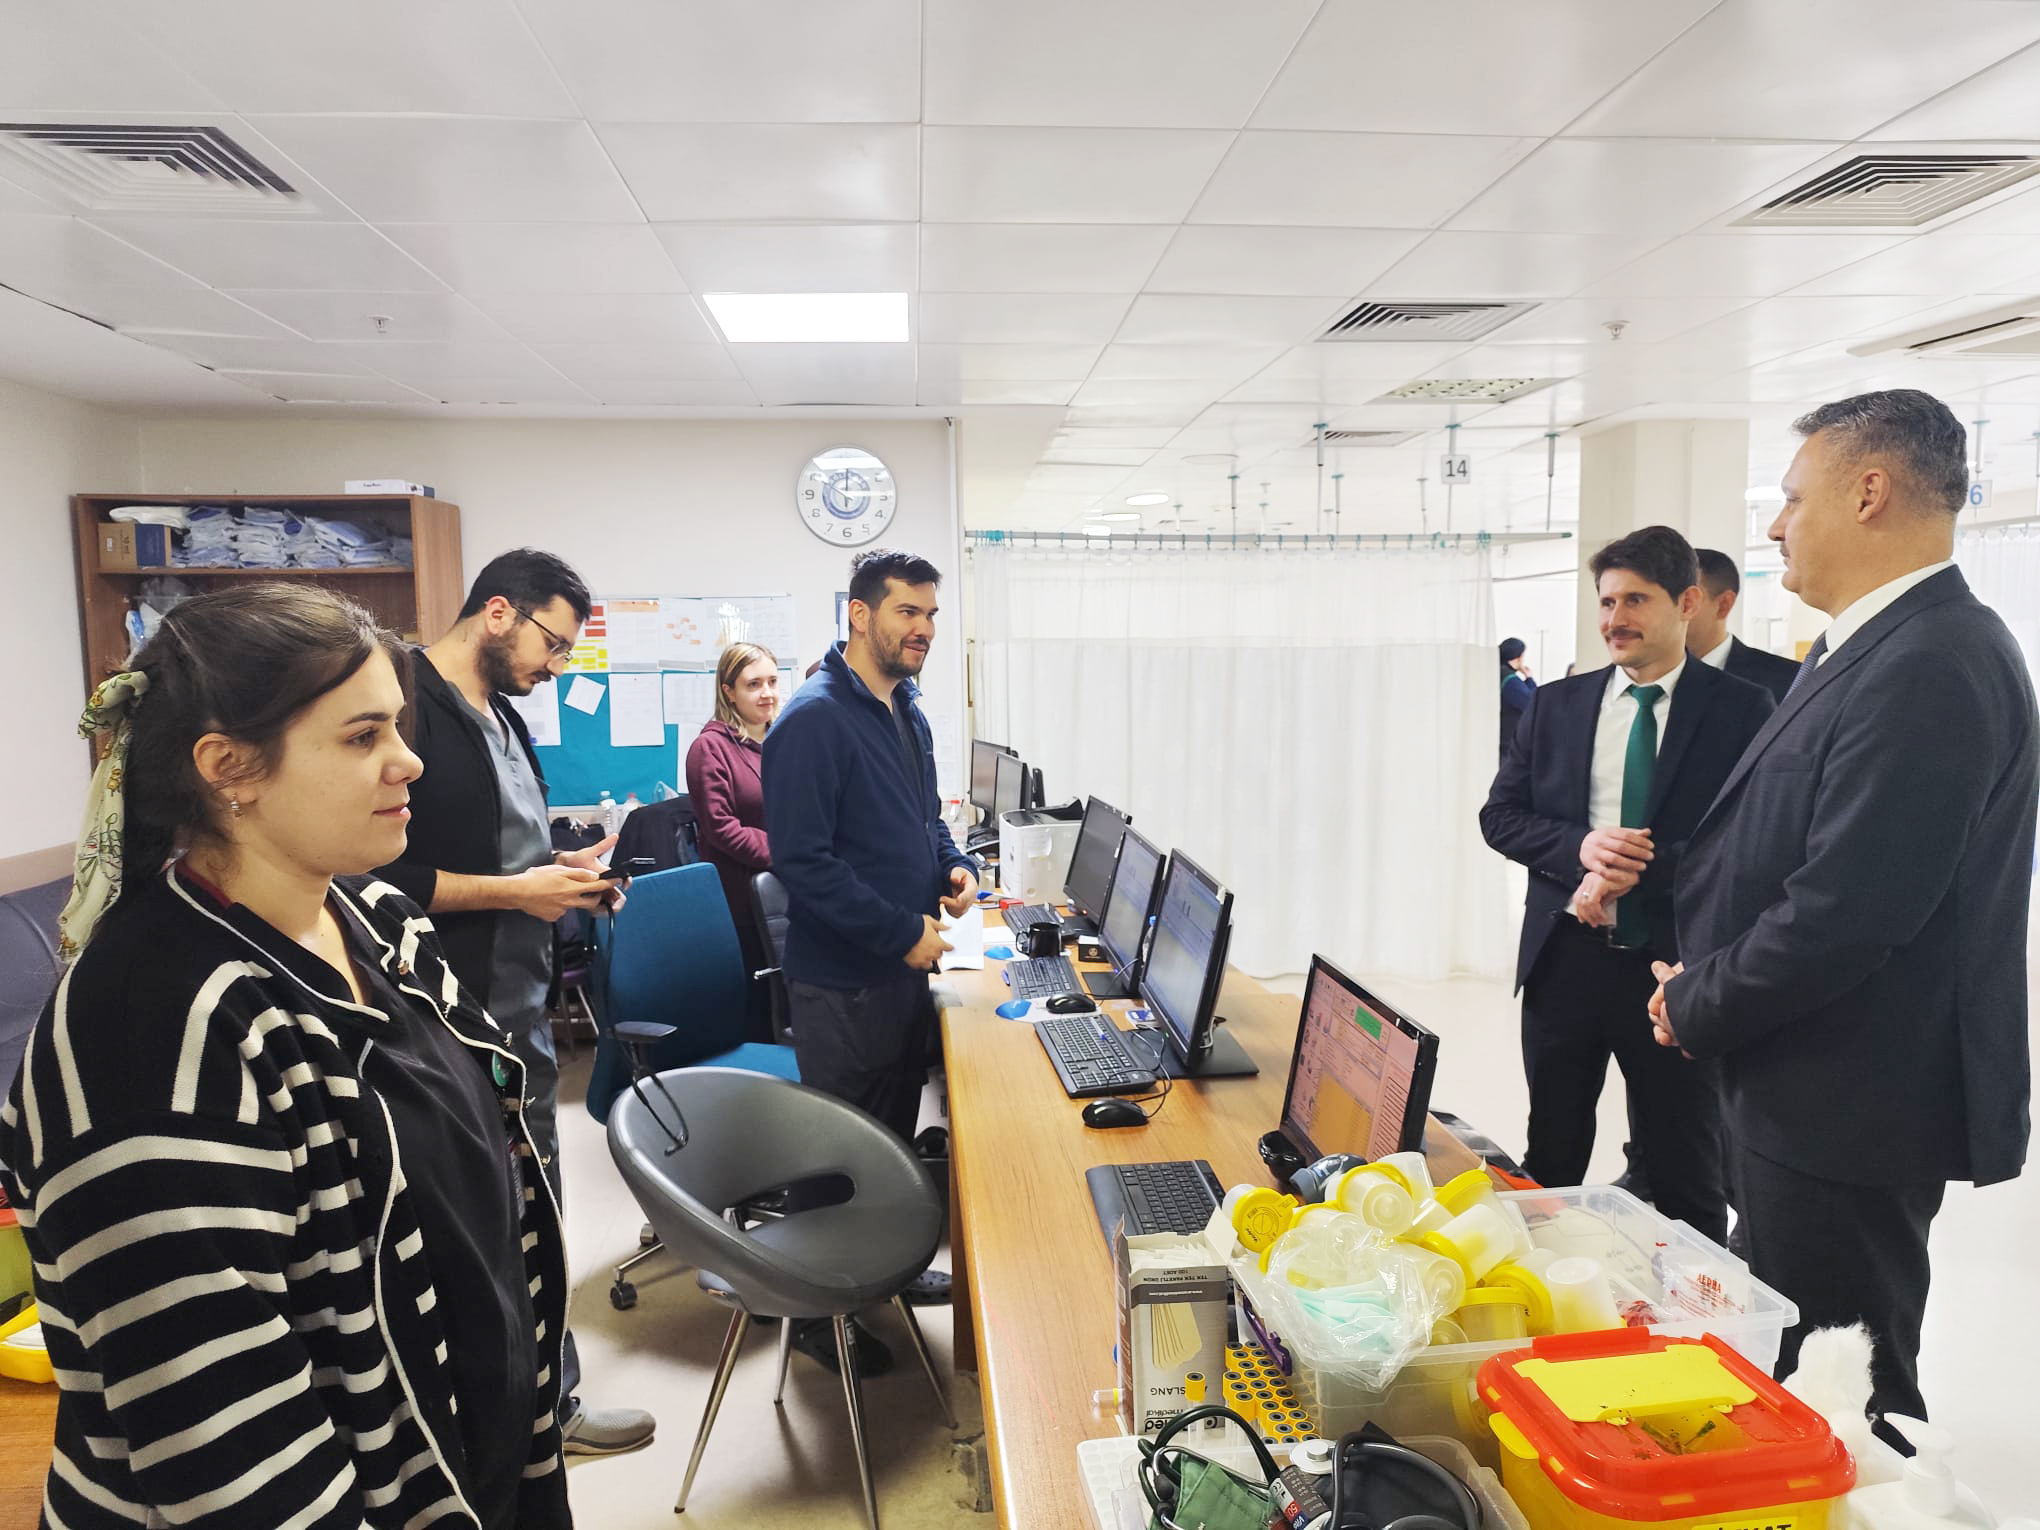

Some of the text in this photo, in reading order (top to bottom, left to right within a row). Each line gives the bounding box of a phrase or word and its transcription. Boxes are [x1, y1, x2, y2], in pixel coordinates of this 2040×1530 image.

[1446, 460, 1468, 477] 14
[804, 489, 815, 500] 9
[1970, 484, 1983, 505] 6
[811, 508, 821, 518] 8
[874, 509, 884, 518] 4
[826, 522, 834, 532] 7
[861, 523, 870, 533] 5
[842, 527, 853, 538] 6
[1146, 1408, 1184, 1417] medikal
[1287, 1503, 1298, 1517] 50
